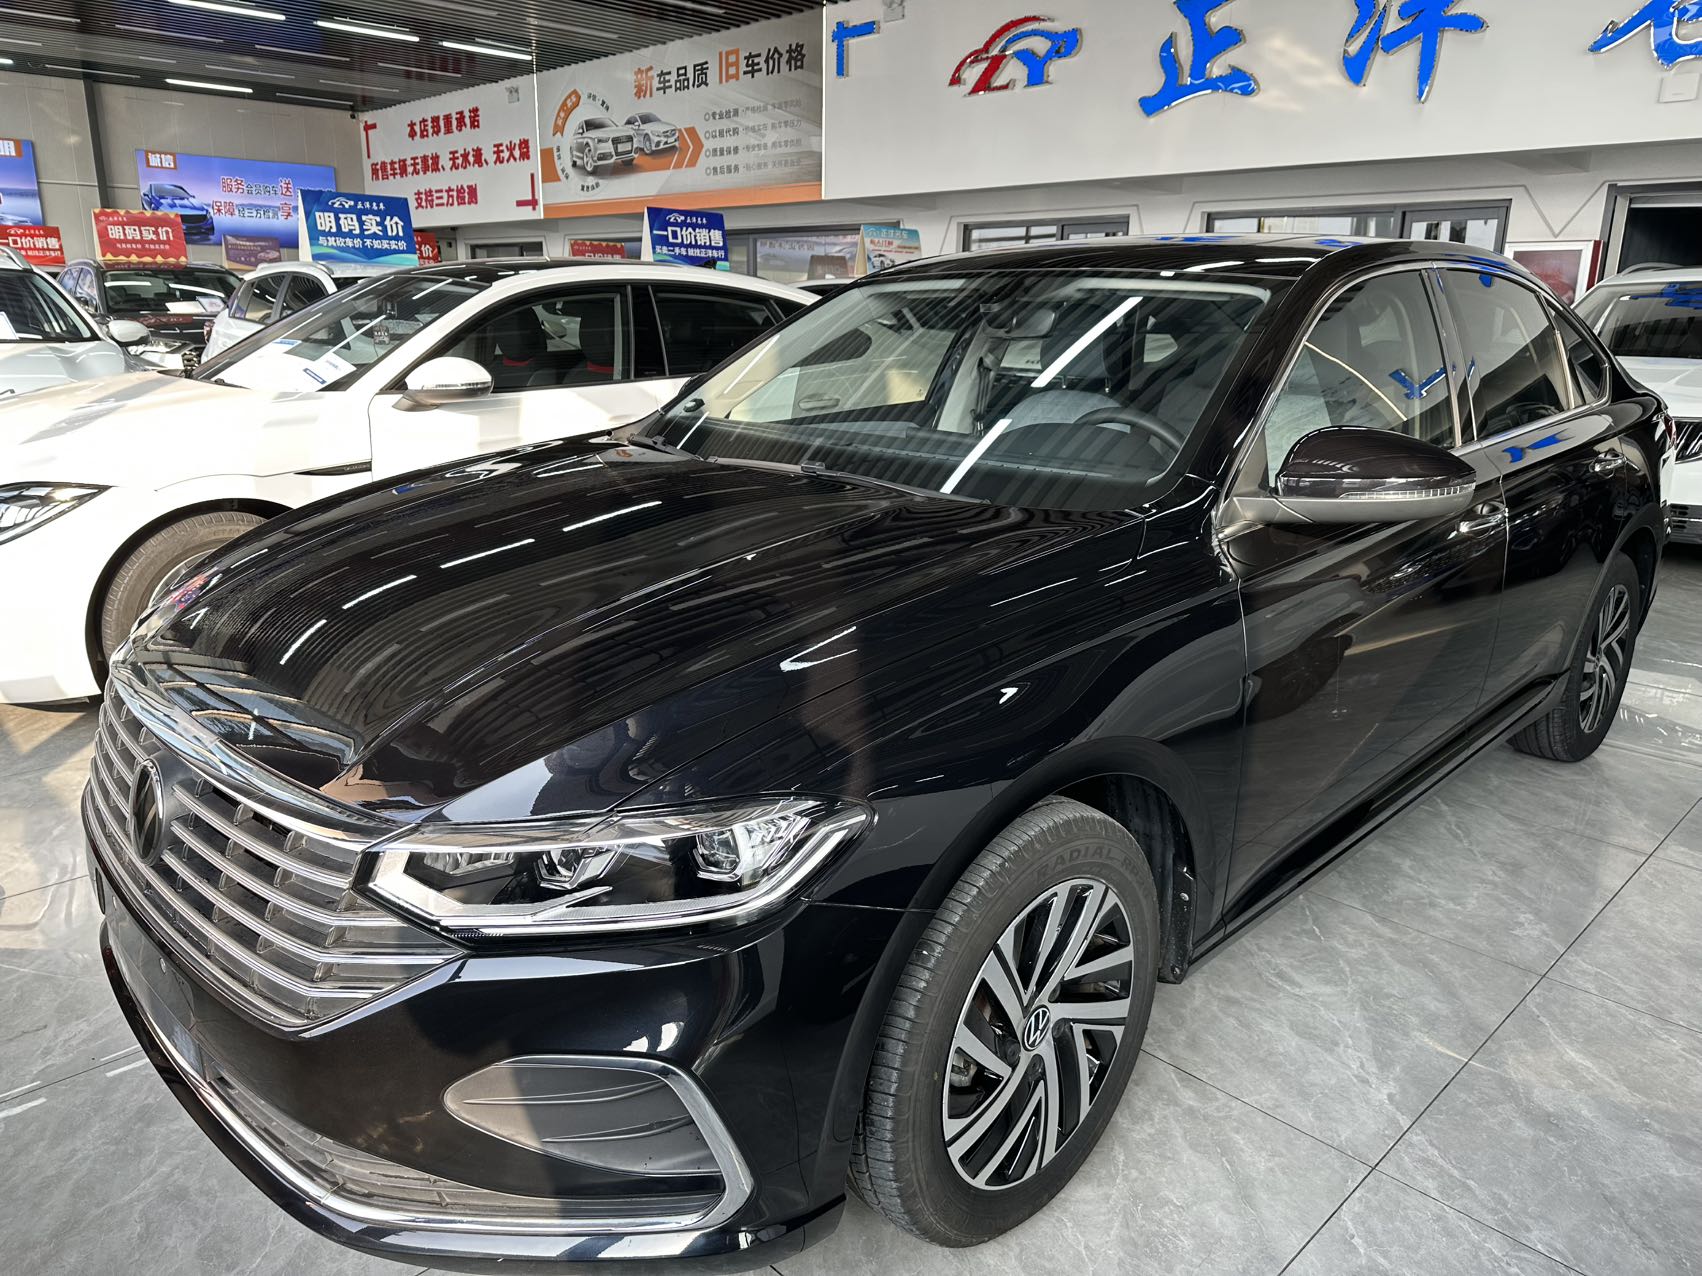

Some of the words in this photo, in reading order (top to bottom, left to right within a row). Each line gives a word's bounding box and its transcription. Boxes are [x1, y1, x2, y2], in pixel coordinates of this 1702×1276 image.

[634, 61, 710, 99] 新车品质
[718, 42, 806, 85] 旧车价格
[407, 106, 480, 141] 本店郑重承诺
[712, 164, 739, 176] 售后服务
[414, 184, 478, 210] 支持三方检测
[107, 225, 173, 240] 明码实价
[315, 211, 404, 237] 明码实价
[318, 236, 363, 249] 与其砍车价
[364, 239, 407, 250] 不如买实价
[653, 226, 723, 247] 一口价销售
